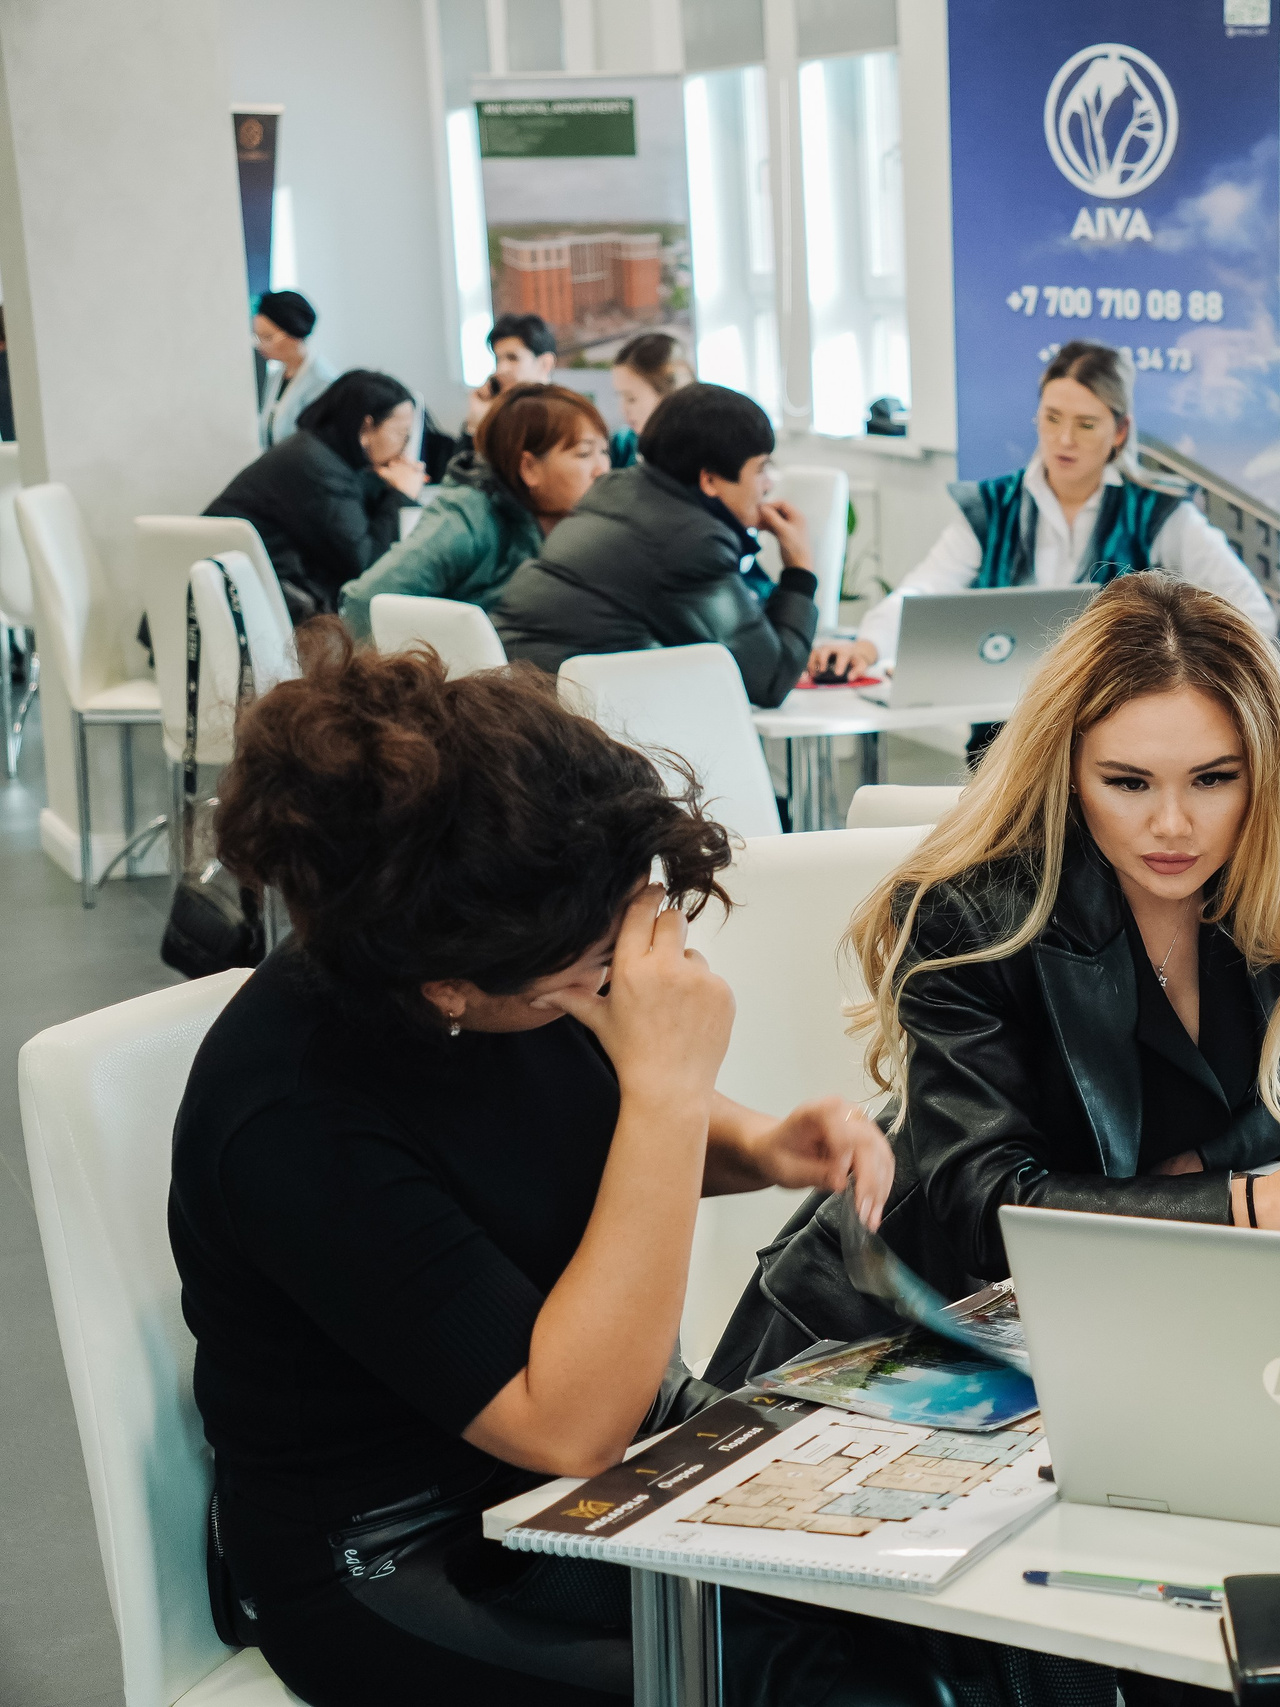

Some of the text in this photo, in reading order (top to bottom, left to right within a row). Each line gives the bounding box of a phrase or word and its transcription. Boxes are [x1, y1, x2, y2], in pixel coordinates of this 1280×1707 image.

[1070, 207, 1153, 242] AIVA
[1006, 285, 1223, 322] +7 700 710 08 88
[1166, 347, 1193, 372] 73
